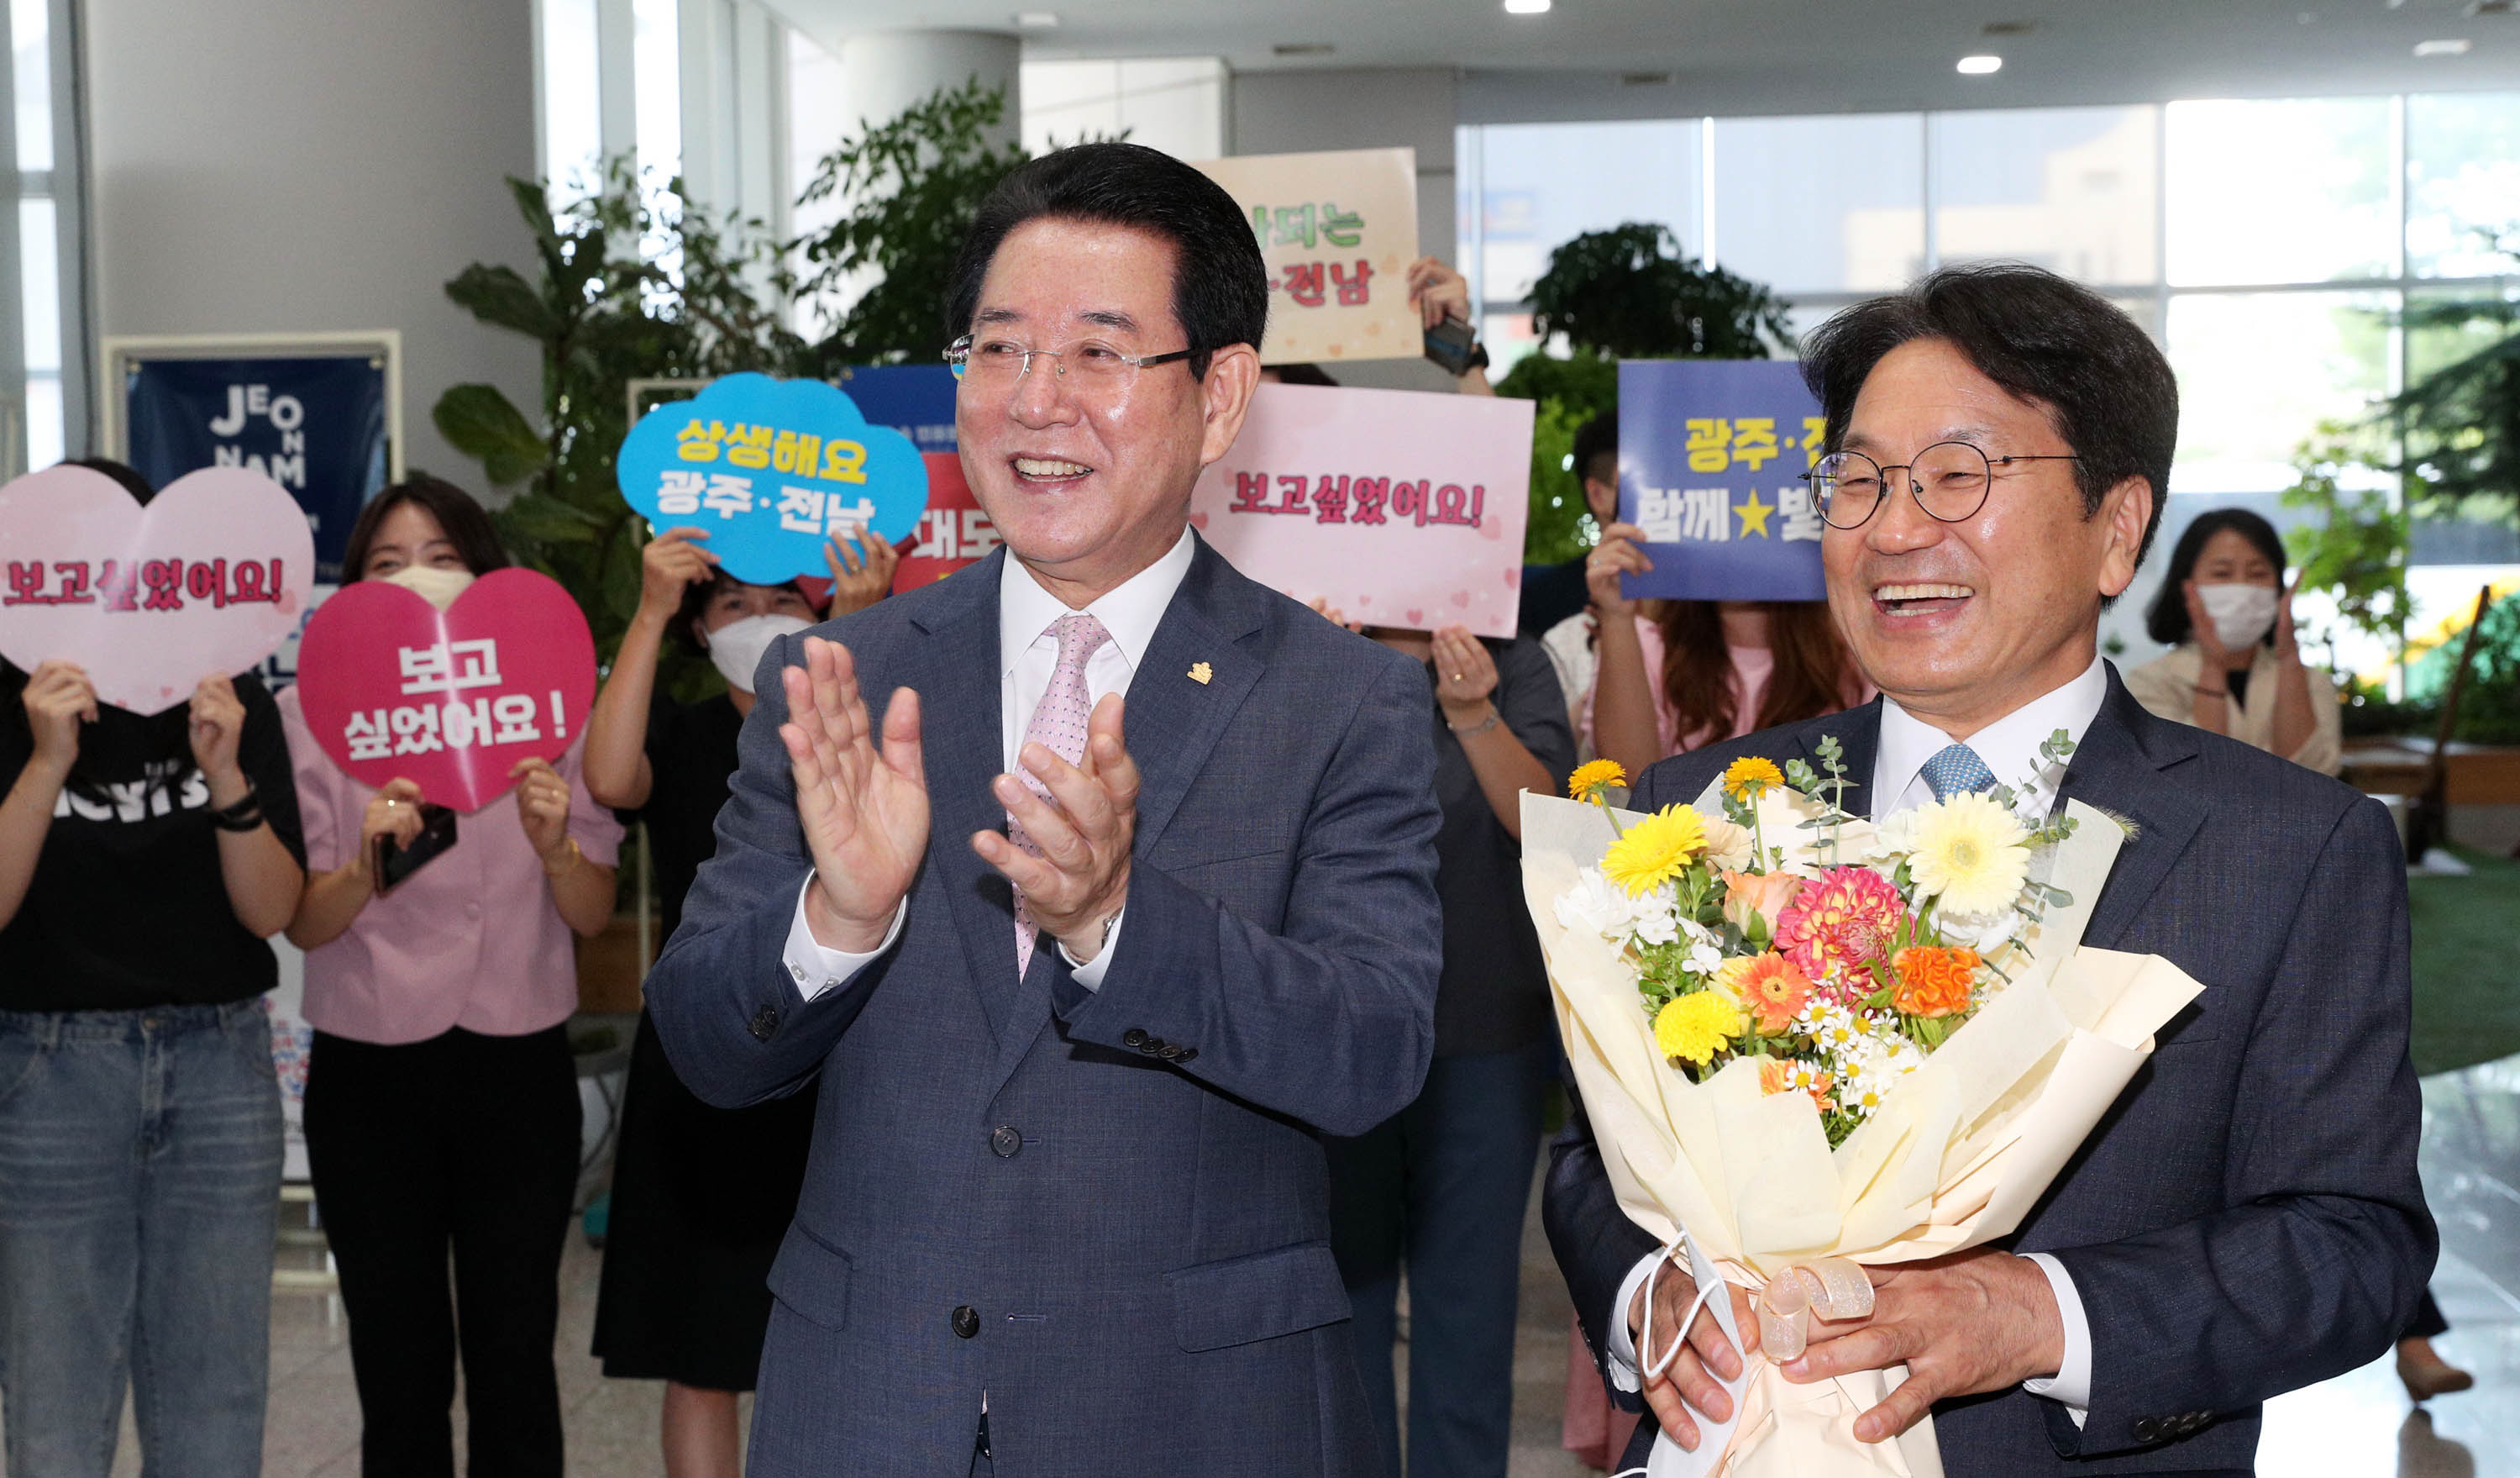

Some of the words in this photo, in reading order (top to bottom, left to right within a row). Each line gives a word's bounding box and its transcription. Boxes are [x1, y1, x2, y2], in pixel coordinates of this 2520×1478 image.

[675, 418, 869, 485] 상생해요
[1230, 471, 1485, 528] 보고싶었어요!
[3, 558, 283, 613] 보고싶었어요!
[398, 639, 502, 695] 보고
